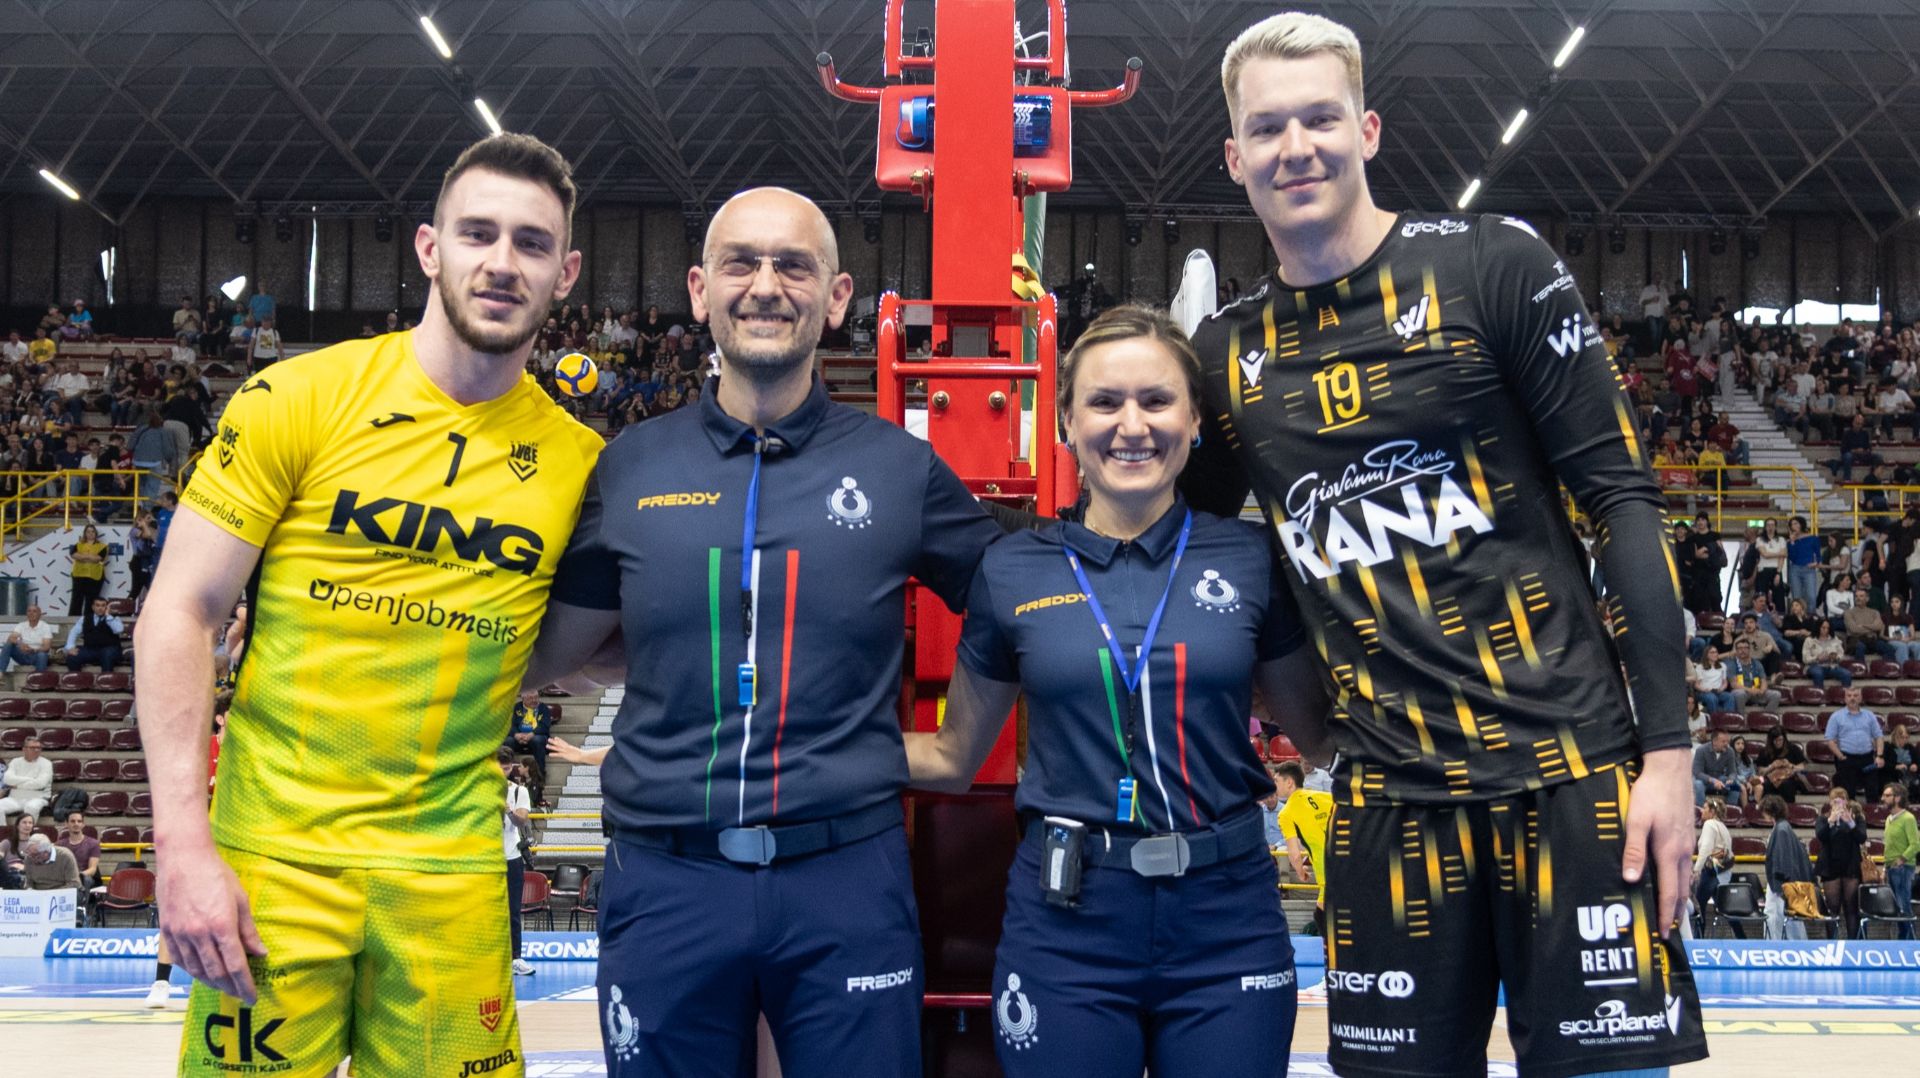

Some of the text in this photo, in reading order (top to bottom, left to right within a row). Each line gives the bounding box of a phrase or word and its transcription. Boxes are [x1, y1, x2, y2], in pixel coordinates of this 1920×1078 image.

[1312, 362, 1361, 426] 19
[444, 432, 467, 487] 1
[510, 444, 538, 464] LUBE
[1286, 440, 1456, 533] Giovanni Rana
[637, 492, 721, 510] FREDDY
[326, 489, 545, 577] KING
[1277, 474, 1494, 585] RANA
[374, 549, 495, 577] FIND YOUR ATTITUDE
[1308, 796, 1319, 810] 6
[3, 897, 20, 905] LEGA
[3, 906, 40, 914] PALLAVOLO
[1577, 903, 1631, 941] UP
[1581, 947, 1634, 972] RENT
[1689, 949, 1723, 965] EY
[847, 967, 913, 992] FREDDY
[1241, 968, 1294, 991] FREDDY
[1332, 1022, 1404, 1042] MAXIMILIAN
[1559, 1011, 1666, 1036] sicurplanet
[1596, 1036, 1625, 1044] SECURITY
[1626, 1035, 1655, 1043] PARTNER
[213, 1060, 257, 1073] CORSETTI
[260, 1061, 293, 1073] KATIA
